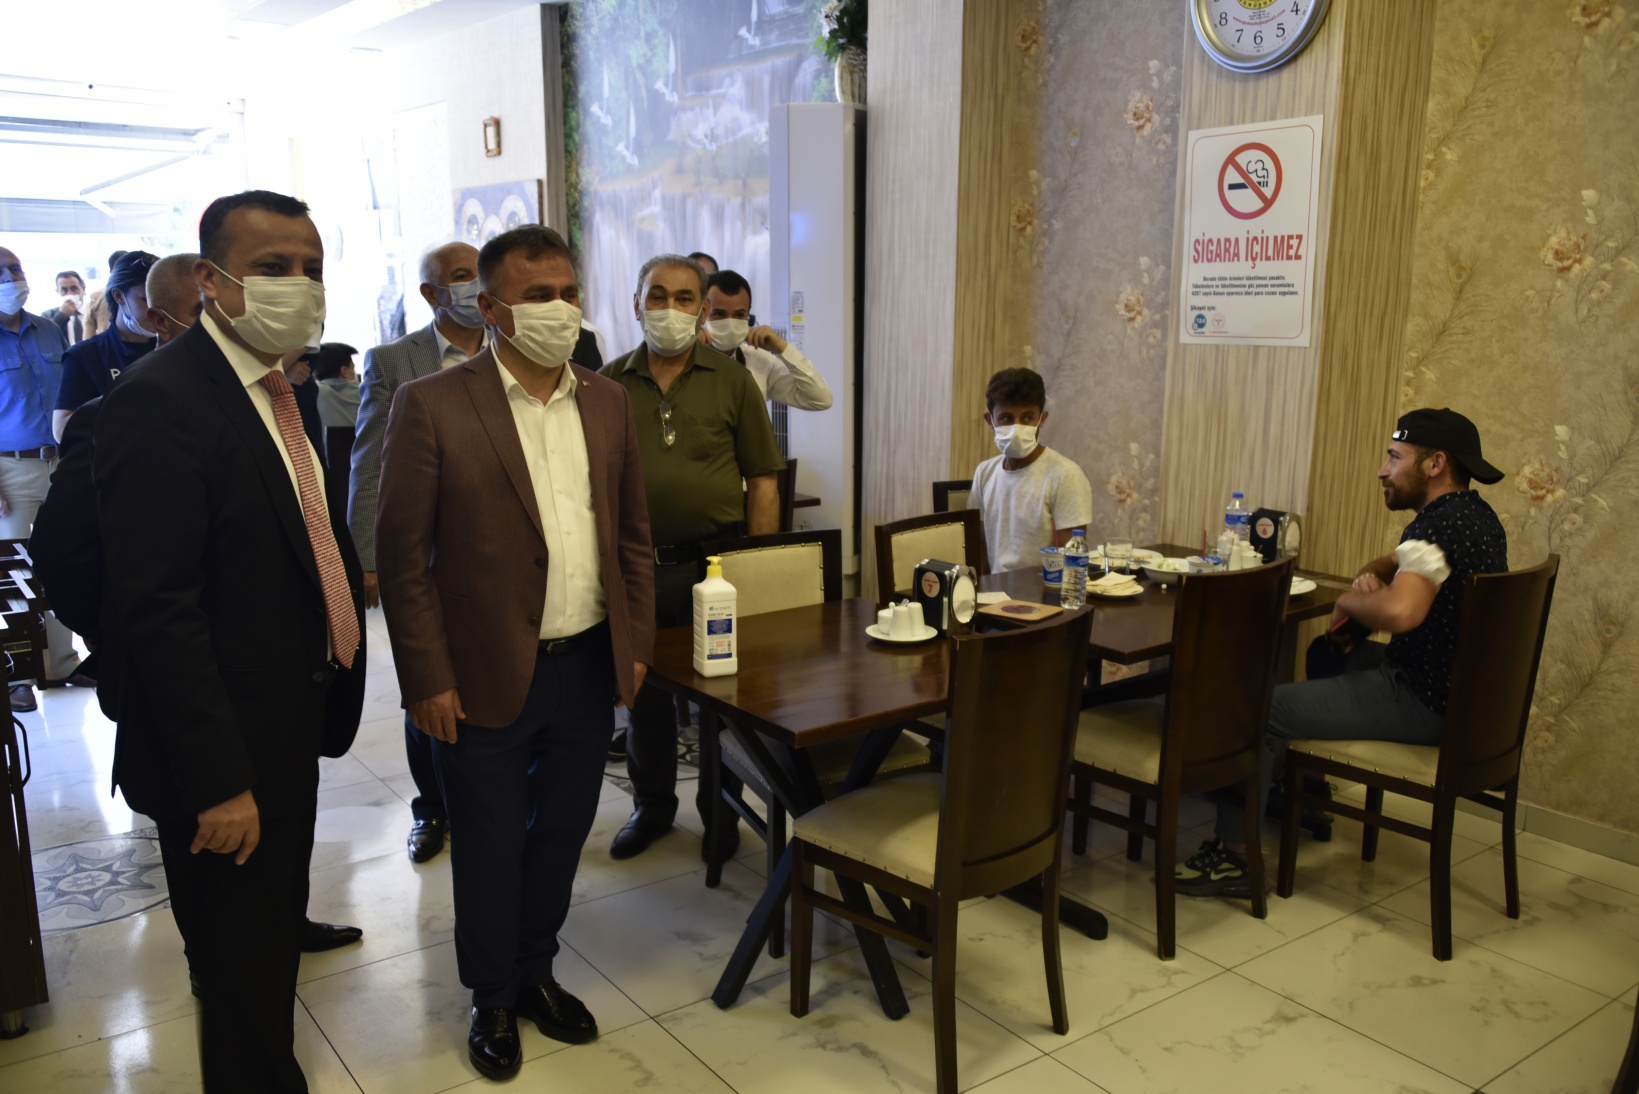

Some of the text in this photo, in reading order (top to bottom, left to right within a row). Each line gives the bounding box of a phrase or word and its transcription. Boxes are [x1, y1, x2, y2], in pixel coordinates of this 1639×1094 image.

[1291, 0, 1300, 15] 4
[1219, 12, 1228, 26] 8
[1235, 28, 1244, 43] 7
[1276, 22, 1286, 38] 5
[1253, 30, 1264, 46] 6
[1193, 229, 1303, 269] SİGARA İÇİLMEZ
[1262, 527, 1268, 536] 6
[928, 583, 933, 594] 7
